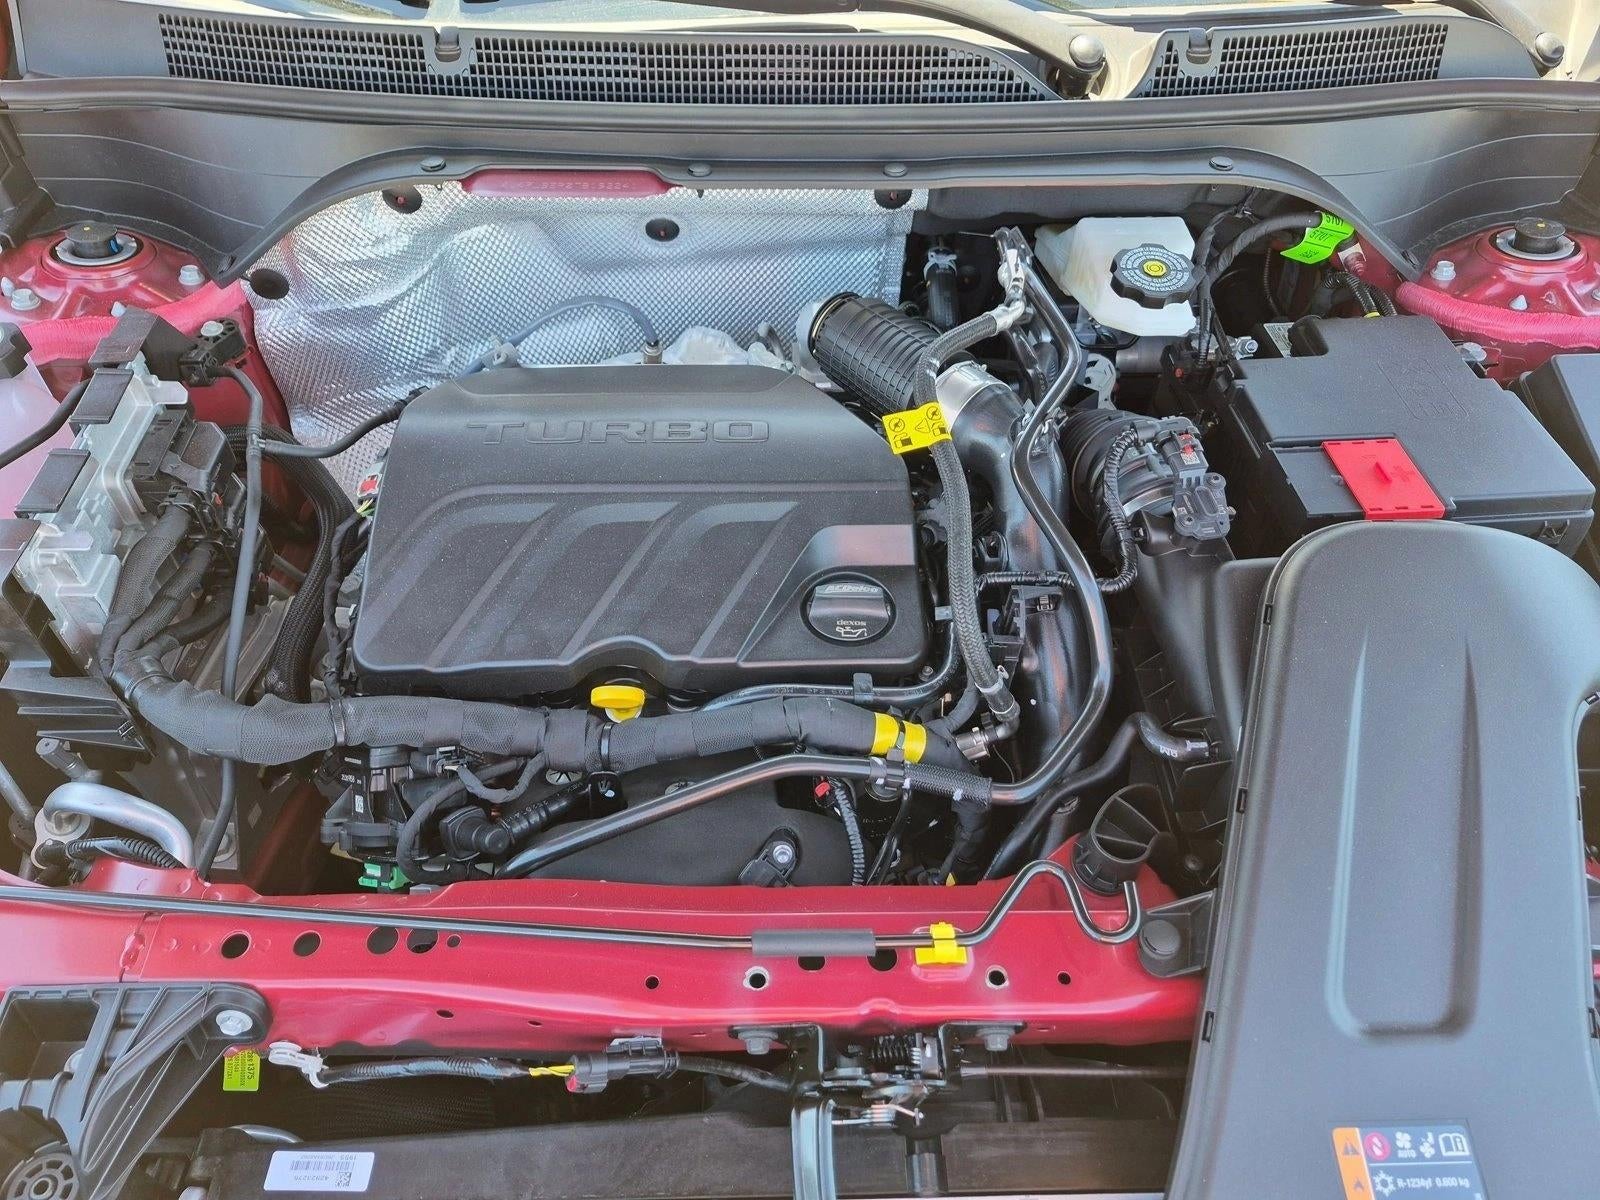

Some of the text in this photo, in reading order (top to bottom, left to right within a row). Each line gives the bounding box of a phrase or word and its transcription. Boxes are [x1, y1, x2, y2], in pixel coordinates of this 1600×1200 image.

[466, 421, 769, 444] TURBO
[824, 584, 879, 593] ACDelco
[1458, 1177, 1470, 1188] kg
